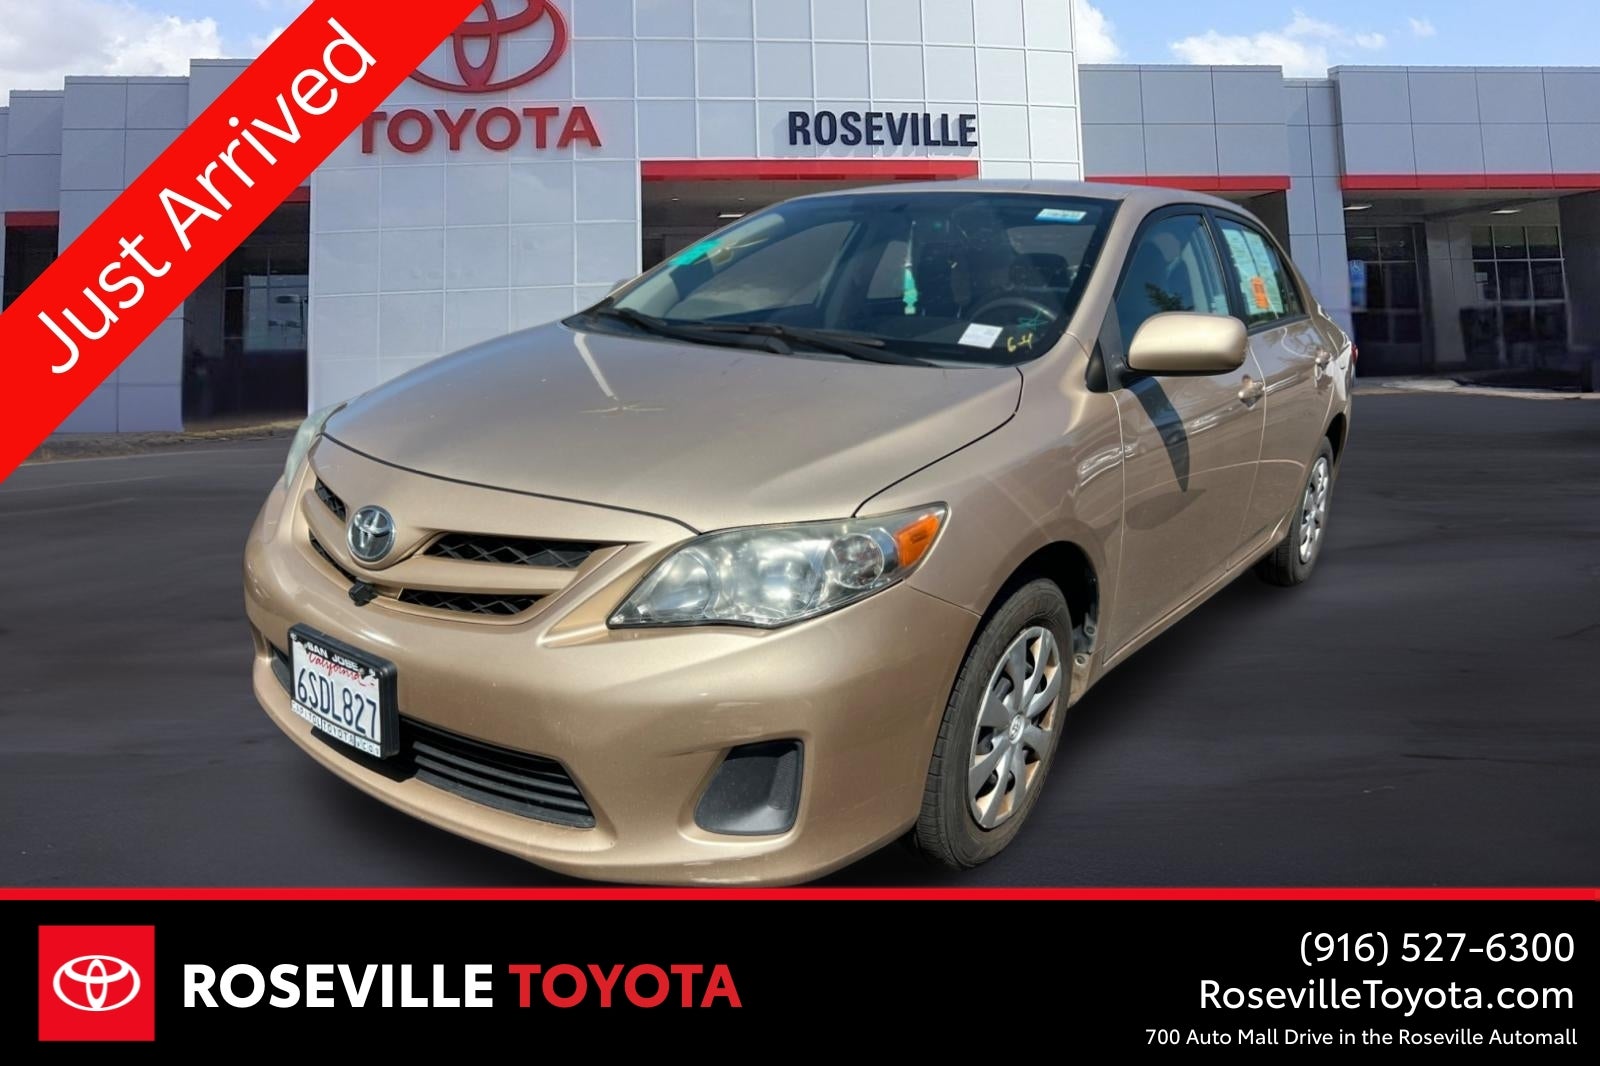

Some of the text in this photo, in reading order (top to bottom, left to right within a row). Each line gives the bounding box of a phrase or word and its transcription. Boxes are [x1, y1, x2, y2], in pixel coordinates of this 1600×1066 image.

[361, 106, 602, 154] TOYOTA
[788, 110, 978, 147] ROSEVILLE
[297, 668, 377, 740] 6SDL827
